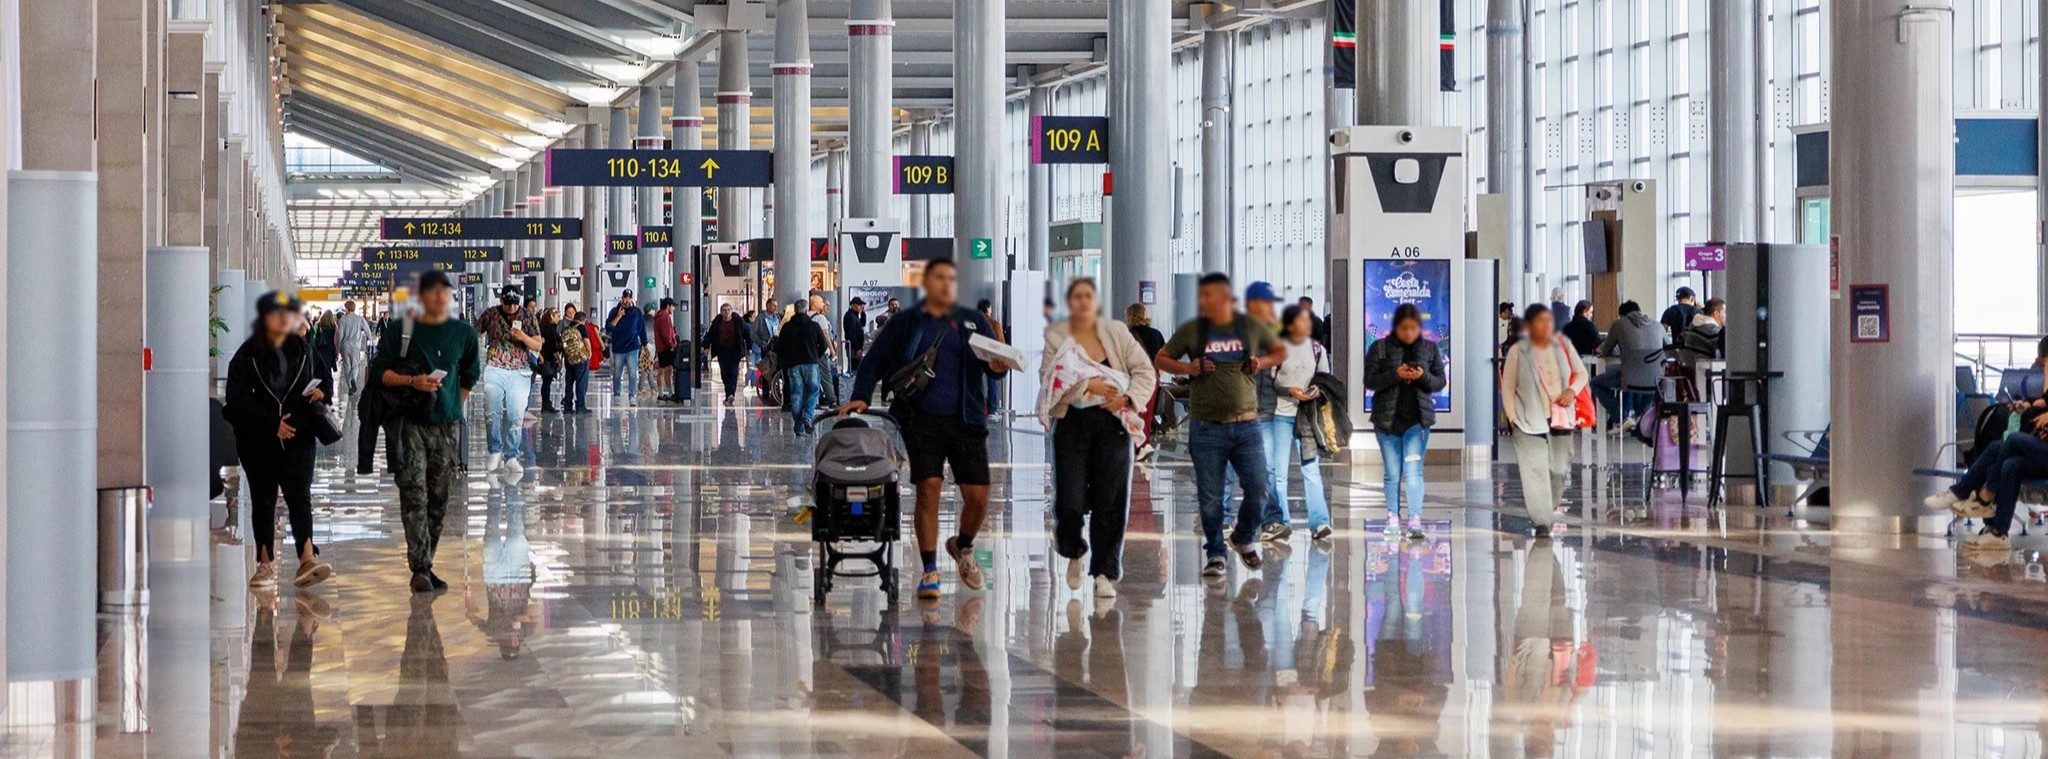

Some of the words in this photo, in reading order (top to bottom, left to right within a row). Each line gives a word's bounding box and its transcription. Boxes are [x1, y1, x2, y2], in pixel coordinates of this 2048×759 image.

[1046, 129, 1081, 152] 109
[1086, 129, 1101, 152] A
[607, 158, 681, 178] 110-134
[903, 166, 932, 185] 109
[936, 166, 948, 185] B
[420, 222, 462, 235] 112-134
[526, 223, 544, 235] 111
[643, 231, 660, 243] 110
[660, 231, 668, 243] A
[611, 240, 626, 250] 110
[626, 240, 634, 250] B
[389, 249, 419, 260] 113-134
[463, 249, 477, 260] 112
[1390, 246, 1401, 258] A
[1404, 246, 1421, 258] 06
[1714, 248, 1725, 262] 3
[511, 264, 520, 272] 111
[526, 260, 535, 269] 111
[535, 260, 541, 269] A
[1382, 285, 1431, 299] Esmeralda
